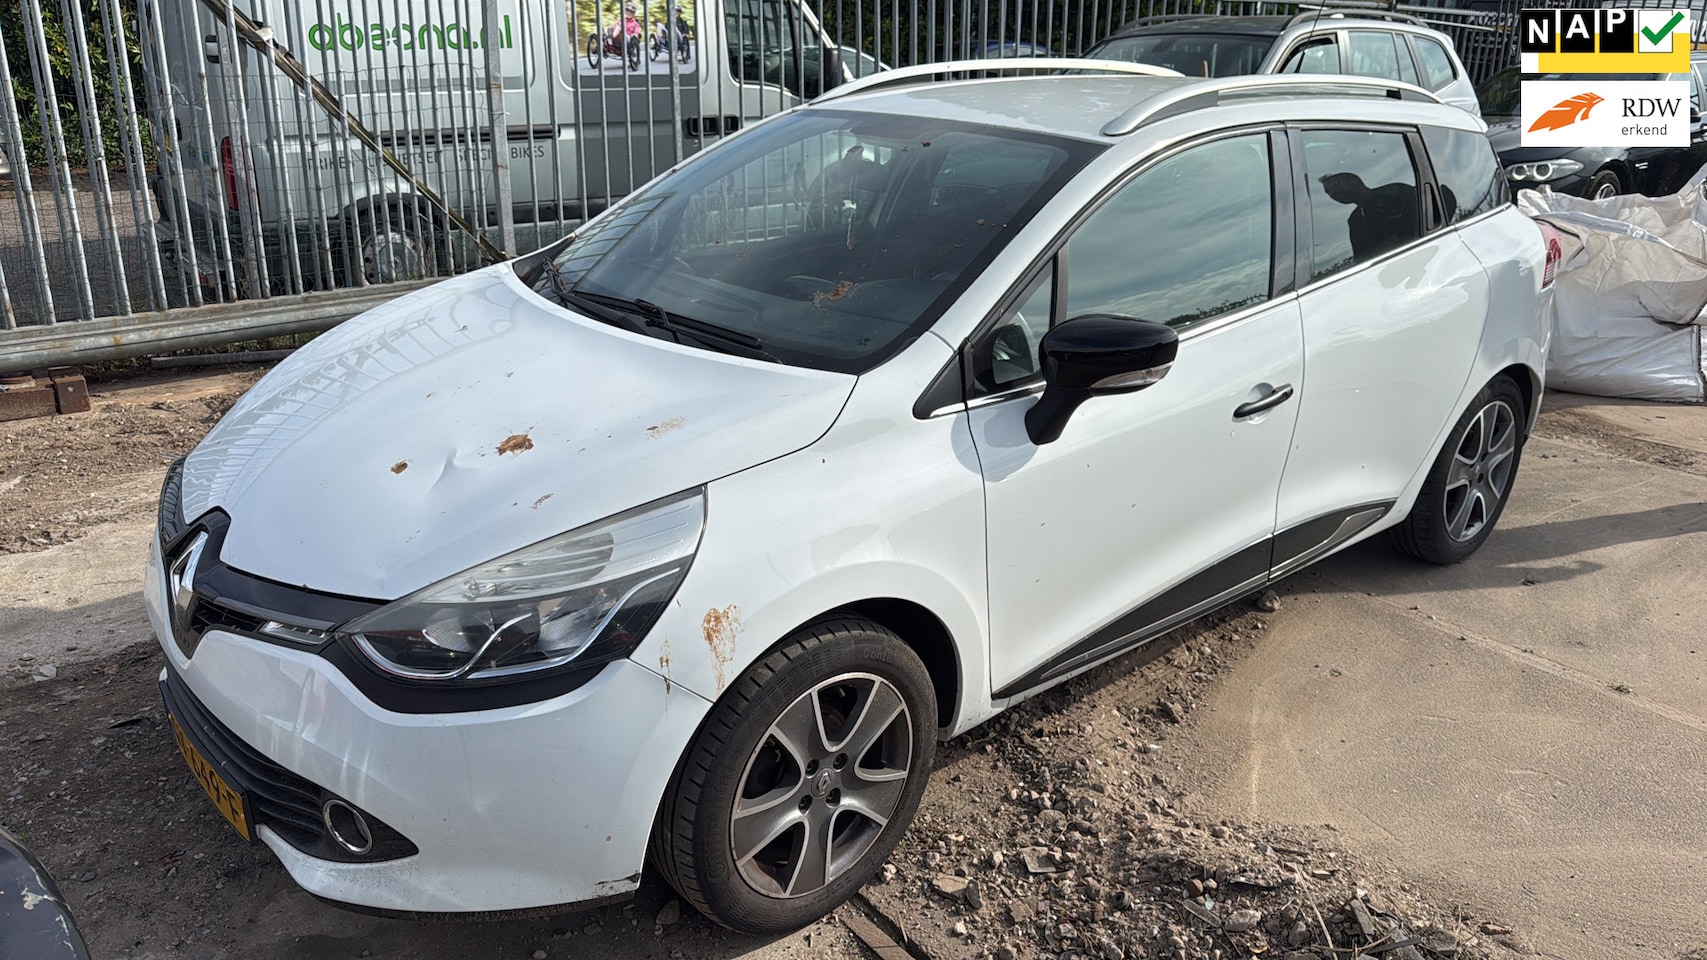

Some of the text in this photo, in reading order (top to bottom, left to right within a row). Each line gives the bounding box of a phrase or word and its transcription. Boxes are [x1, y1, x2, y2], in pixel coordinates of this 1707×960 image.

[306, 155, 354, 170] TRIE
[456, 147, 506, 161] SECI
[511, 146, 544, 159] BIKES
